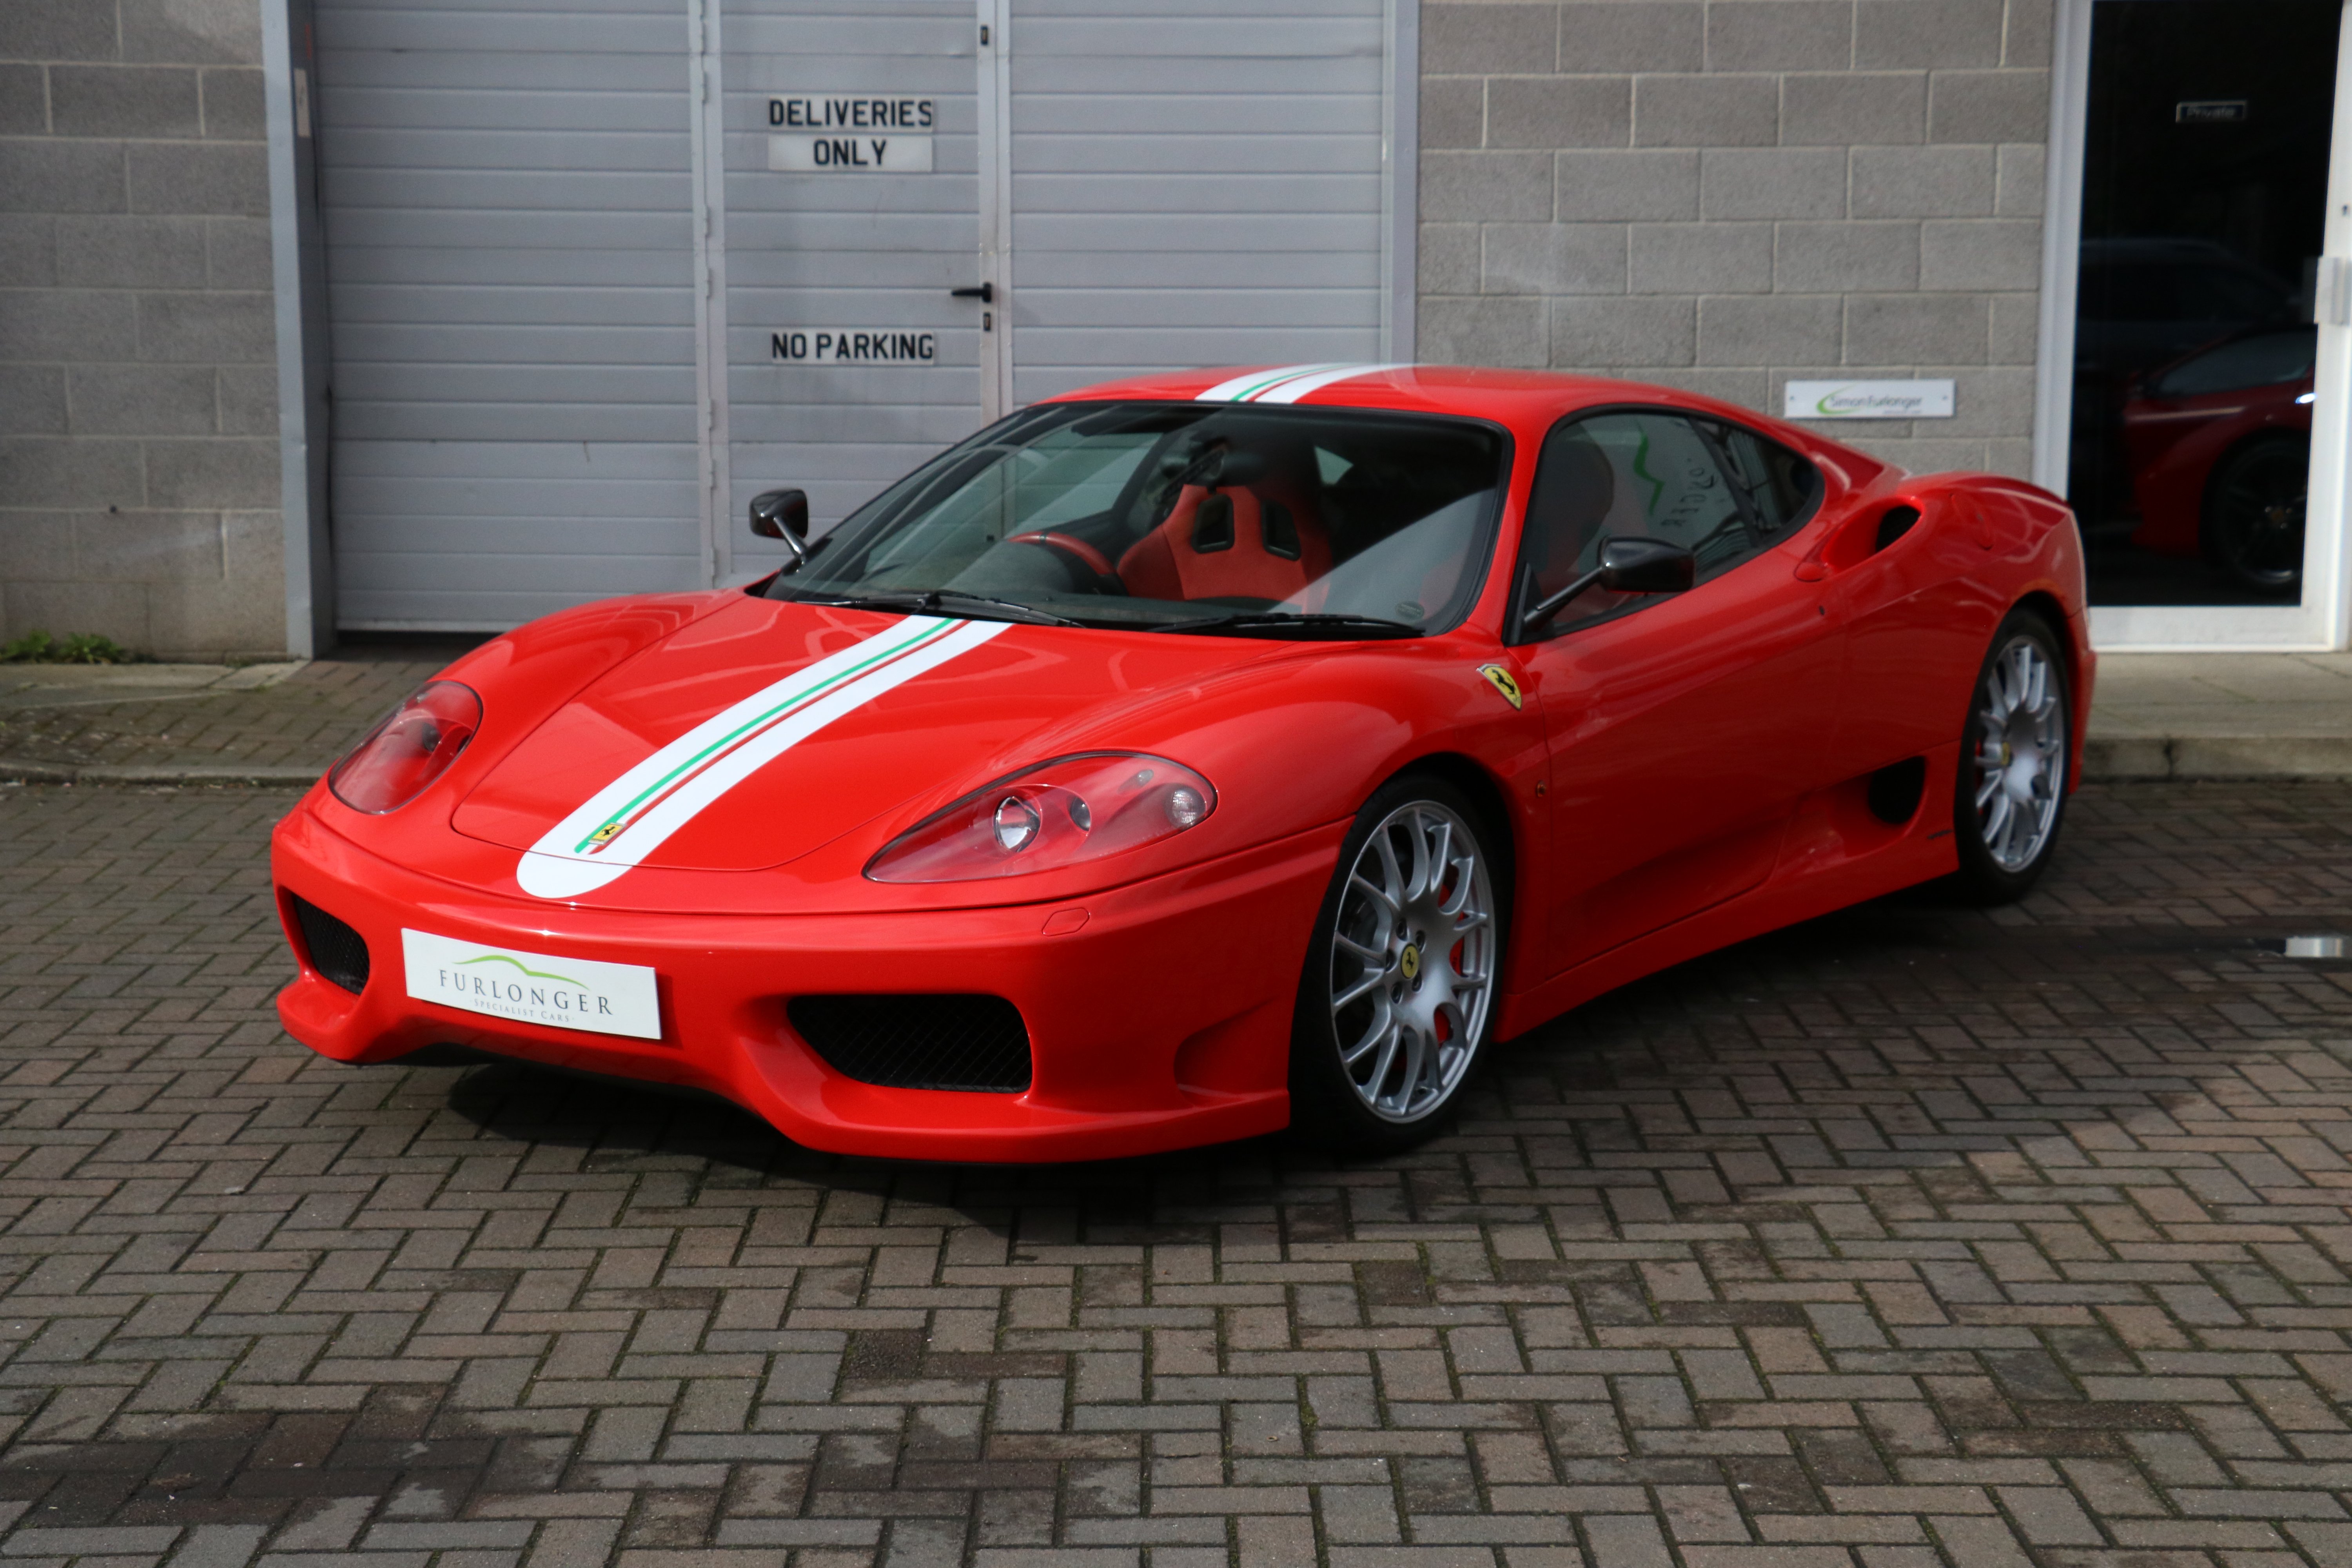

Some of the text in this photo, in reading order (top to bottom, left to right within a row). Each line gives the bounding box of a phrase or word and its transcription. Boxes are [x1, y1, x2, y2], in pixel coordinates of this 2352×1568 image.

[769, 99, 932, 126] DELIVERIES
[814, 138, 886, 165] ONLY
[772, 333, 933, 359] NO PARKING
[439, 969, 613, 1015] FURLONGER
[474, 998, 569, 1022] SPECIALIST CARS
